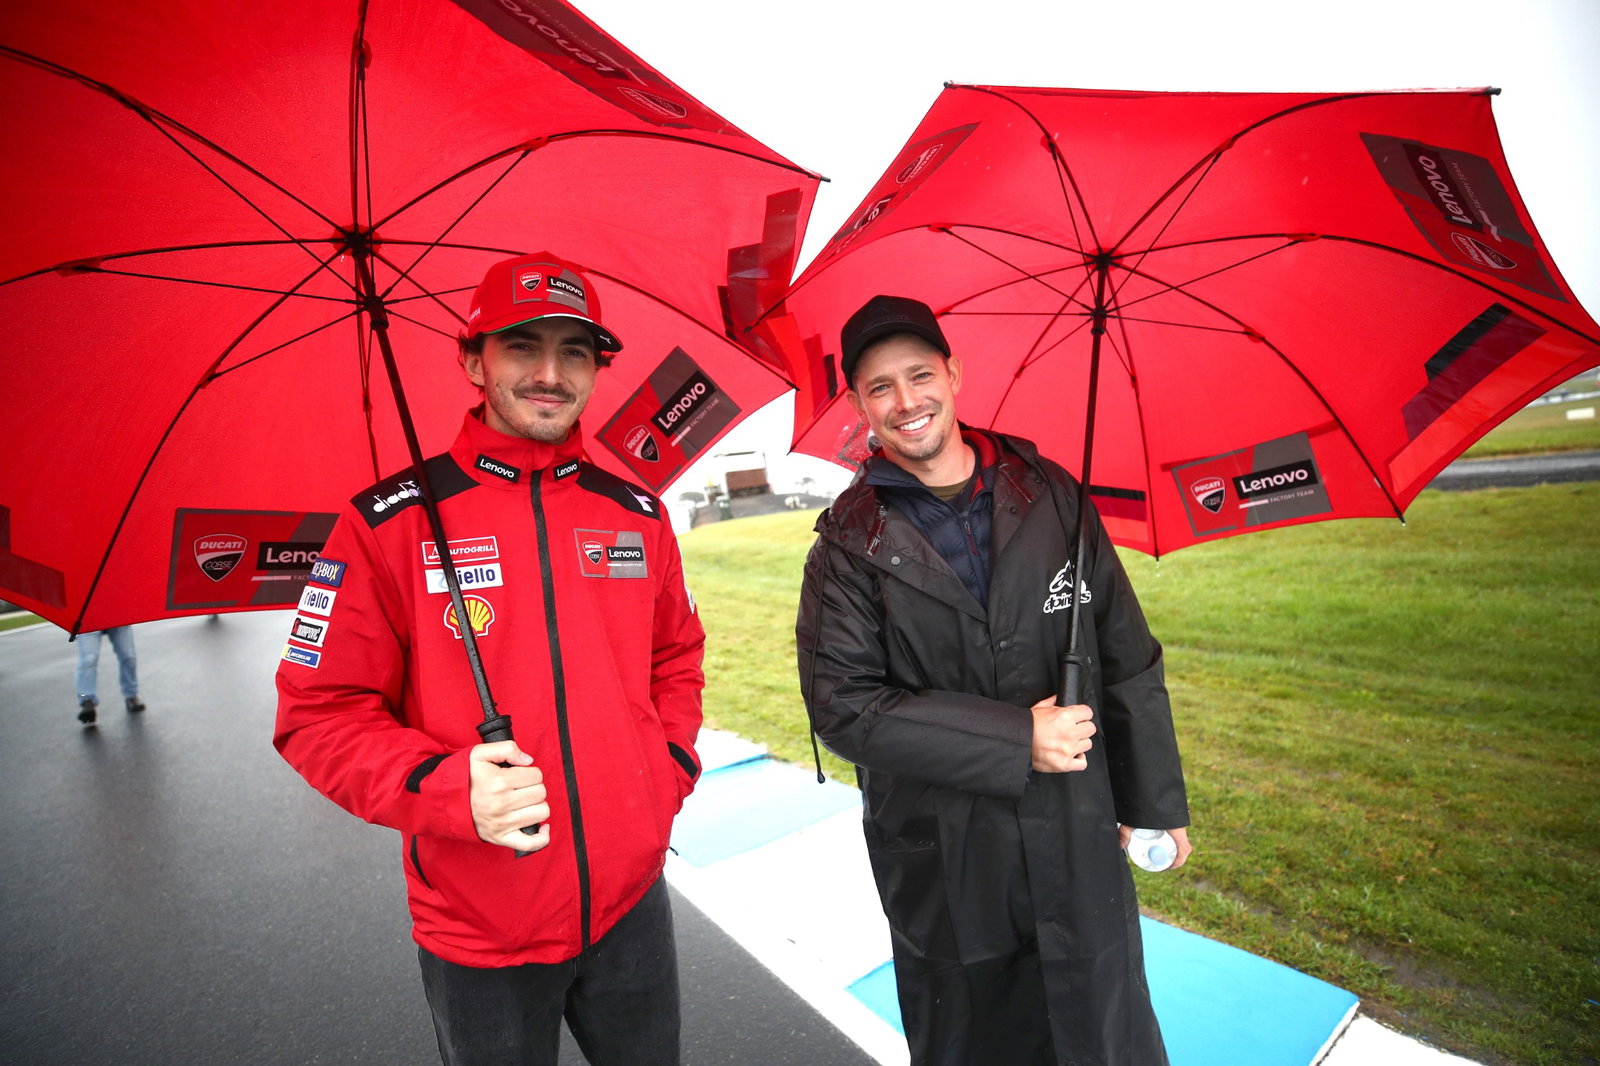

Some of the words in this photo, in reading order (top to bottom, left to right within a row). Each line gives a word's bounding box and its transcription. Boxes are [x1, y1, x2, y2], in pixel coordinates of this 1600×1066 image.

[1418, 155, 1473, 225] Lenovo
[551, 277, 583, 296] Lenovo
[658, 382, 706, 429] Lenovo
[627, 428, 645, 450] DUCATI
[480, 458, 515, 478] Lenovo
[556, 463, 577, 477] Lenovo
[1194, 481, 1221, 493] DUCATI
[1240, 469, 1309, 493] Lenovo
[373, 481, 420, 512] diado
[200, 541, 242, 549] DUCATI
[609, 549, 641, 558] Lenovo
[205, 560, 233, 570] CORSE
[266, 548, 322, 563] Leno
[457, 568, 496, 585] iello
[304, 590, 329, 609] riello
